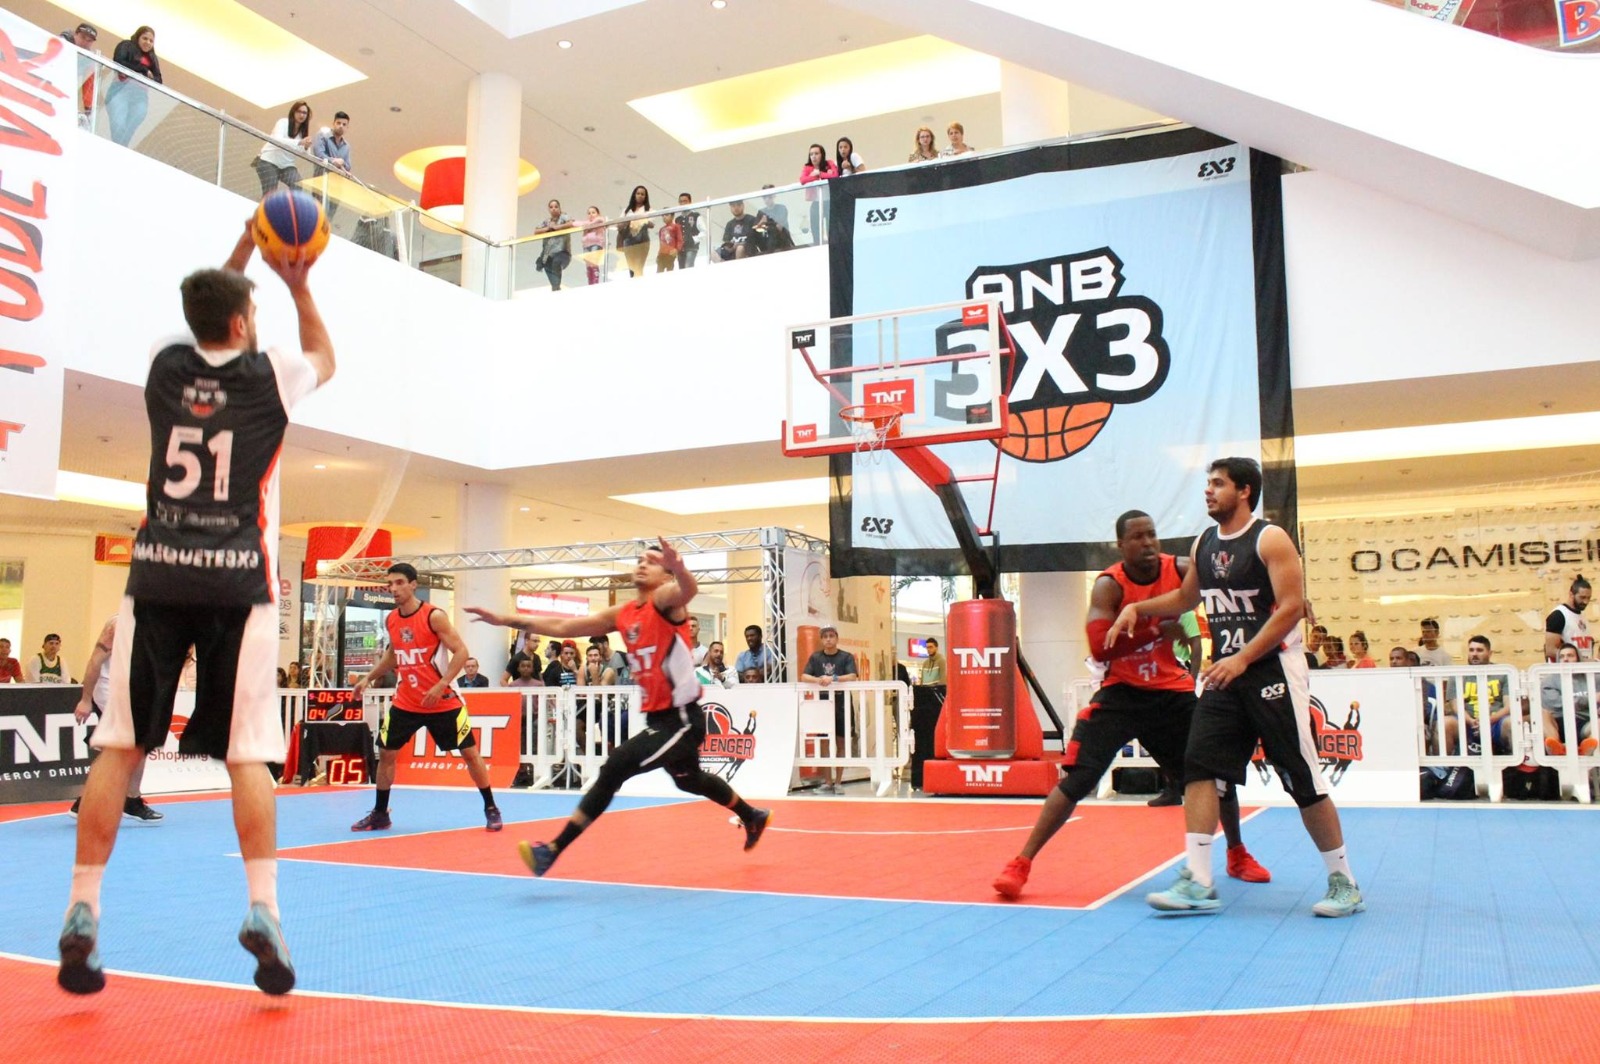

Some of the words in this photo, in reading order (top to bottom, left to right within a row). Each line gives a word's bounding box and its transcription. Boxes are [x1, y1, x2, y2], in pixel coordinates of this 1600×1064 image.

[972, 254, 1117, 314] ANB
[795, 333, 813, 343] TNT
[945, 307, 1160, 410] 3X3
[870, 389, 907, 404] TNT
[796, 428, 813, 438] TNT
[162, 425, 234, 502] 51
[1200, 587, 1261, 616] TNT
[1219, 628, 1247, 656] 24
[394, 648, 428, 666] TNT
[952, 647, 1010, 669] TNT
[407, 673, 419, 689] 9
[308, 709, 326, 720] 04
[345, 709, 363, 720] 03
[49, 766, 91, 778] DRINK
[329, 758, 363, 785] 05
[409, 762, 453, 770] ENERGY
[958, 764, 1011, 783] TNT
